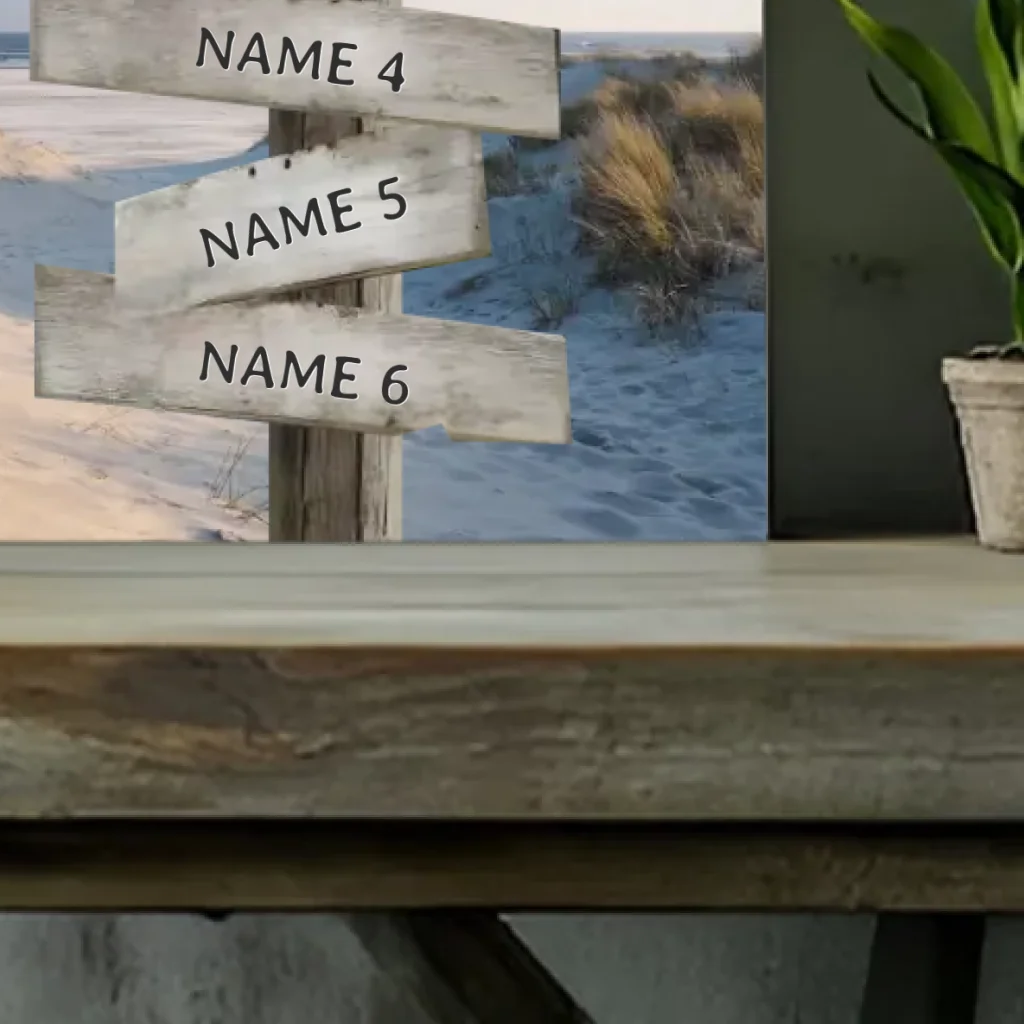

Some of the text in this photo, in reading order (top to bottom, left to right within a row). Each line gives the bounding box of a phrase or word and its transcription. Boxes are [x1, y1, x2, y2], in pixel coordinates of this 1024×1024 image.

[196, 27, 405, 92] NAME 4
[199, 176, 407, 268] NAME 5
[199, 341, 409, 405] NAME 6
